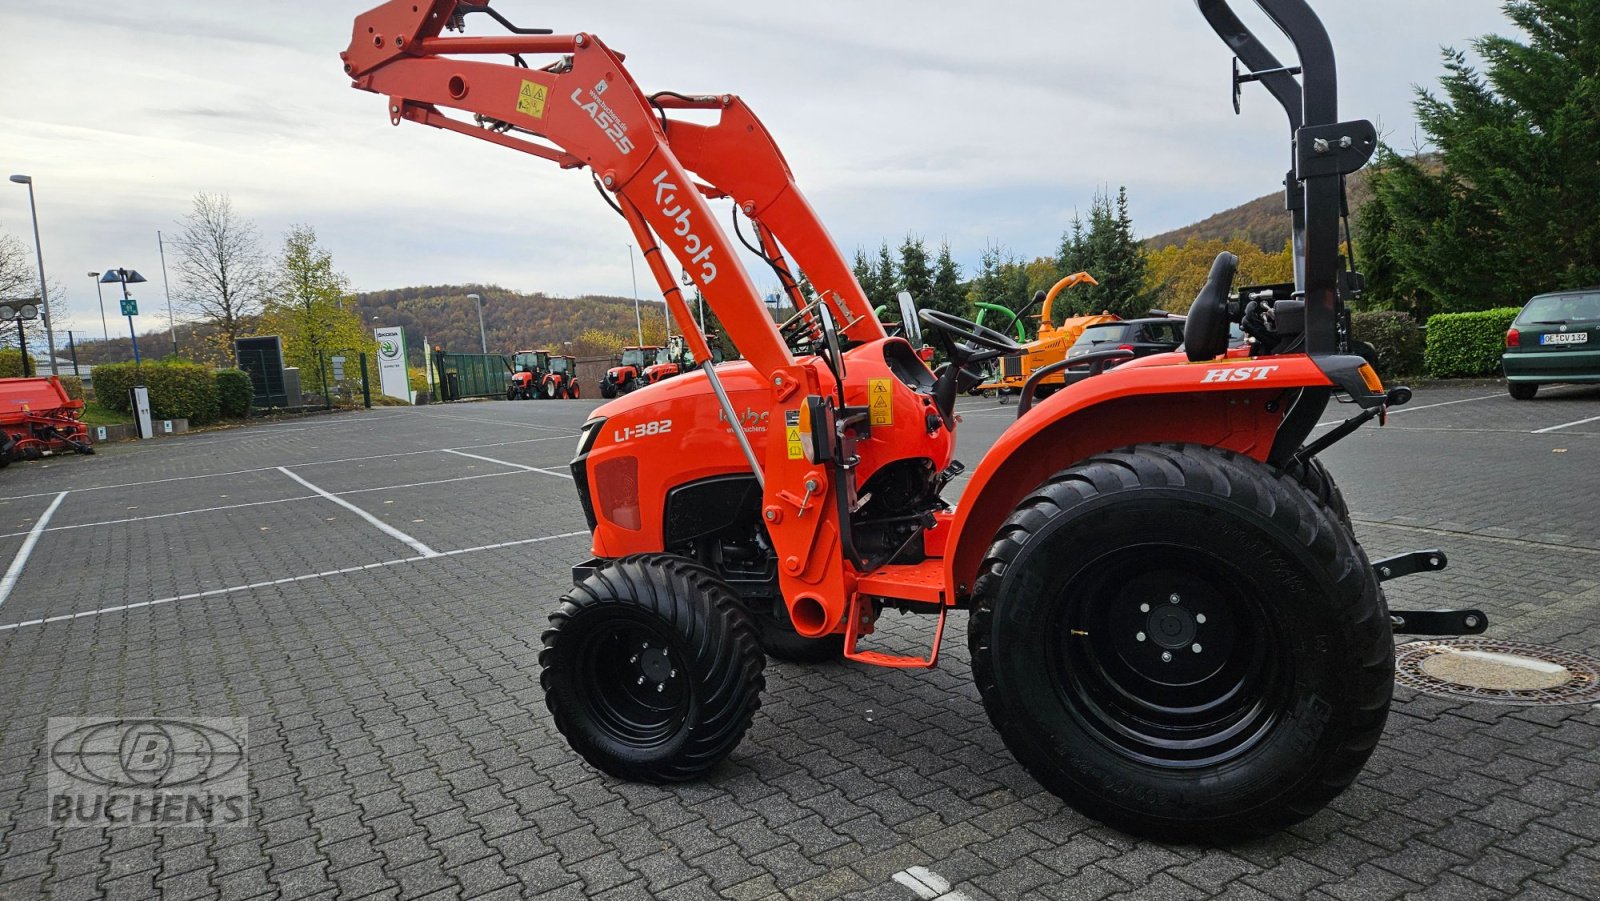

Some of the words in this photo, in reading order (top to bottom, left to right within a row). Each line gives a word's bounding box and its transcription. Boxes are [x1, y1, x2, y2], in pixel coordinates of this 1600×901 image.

[571, 87, 635, 154] LA525
[652, 169, 717, 285] Kubota
[1559, 334, 1570, 342] CV
[1571, 334, 1586, 342] 132
[1199, 365, 1280, 384] HST
[614, 419, 673, 443] L1-382
